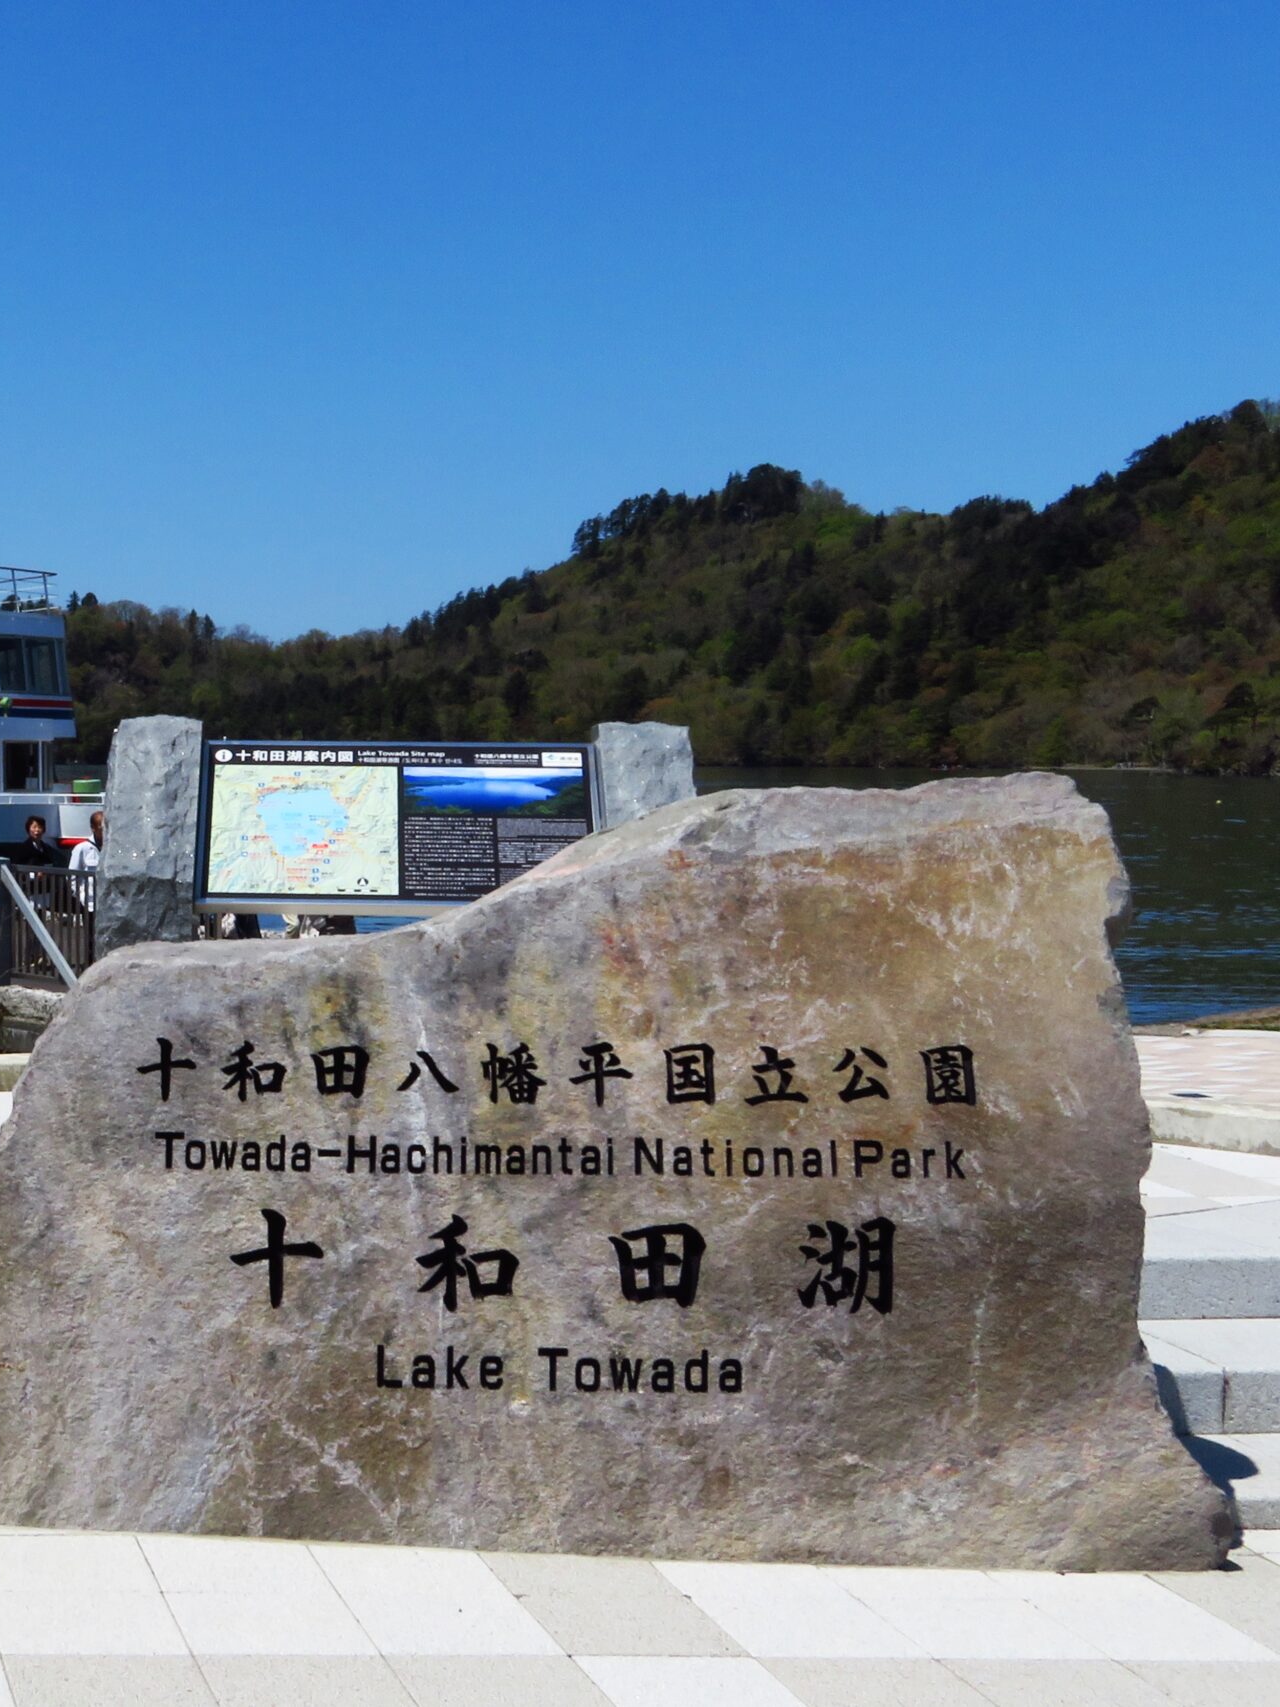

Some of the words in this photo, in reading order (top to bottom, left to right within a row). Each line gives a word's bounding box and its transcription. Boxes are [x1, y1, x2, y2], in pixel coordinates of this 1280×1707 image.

[235, 749, 354, 763] 十和田湖案内図
[136, 1038, 977, 1107] 十和田八幡平国立公園
[155, 1131, 614, 1176] Towada-Hachimantai
[634, 1136, 838, 1179] National
[853, 1139, 966, 1180] Park
[230, 1208, 898, 1316] 十和田湖
[376, 1344, 504, 1391] Lake
[537, 1347, 743, 1394] Towada
